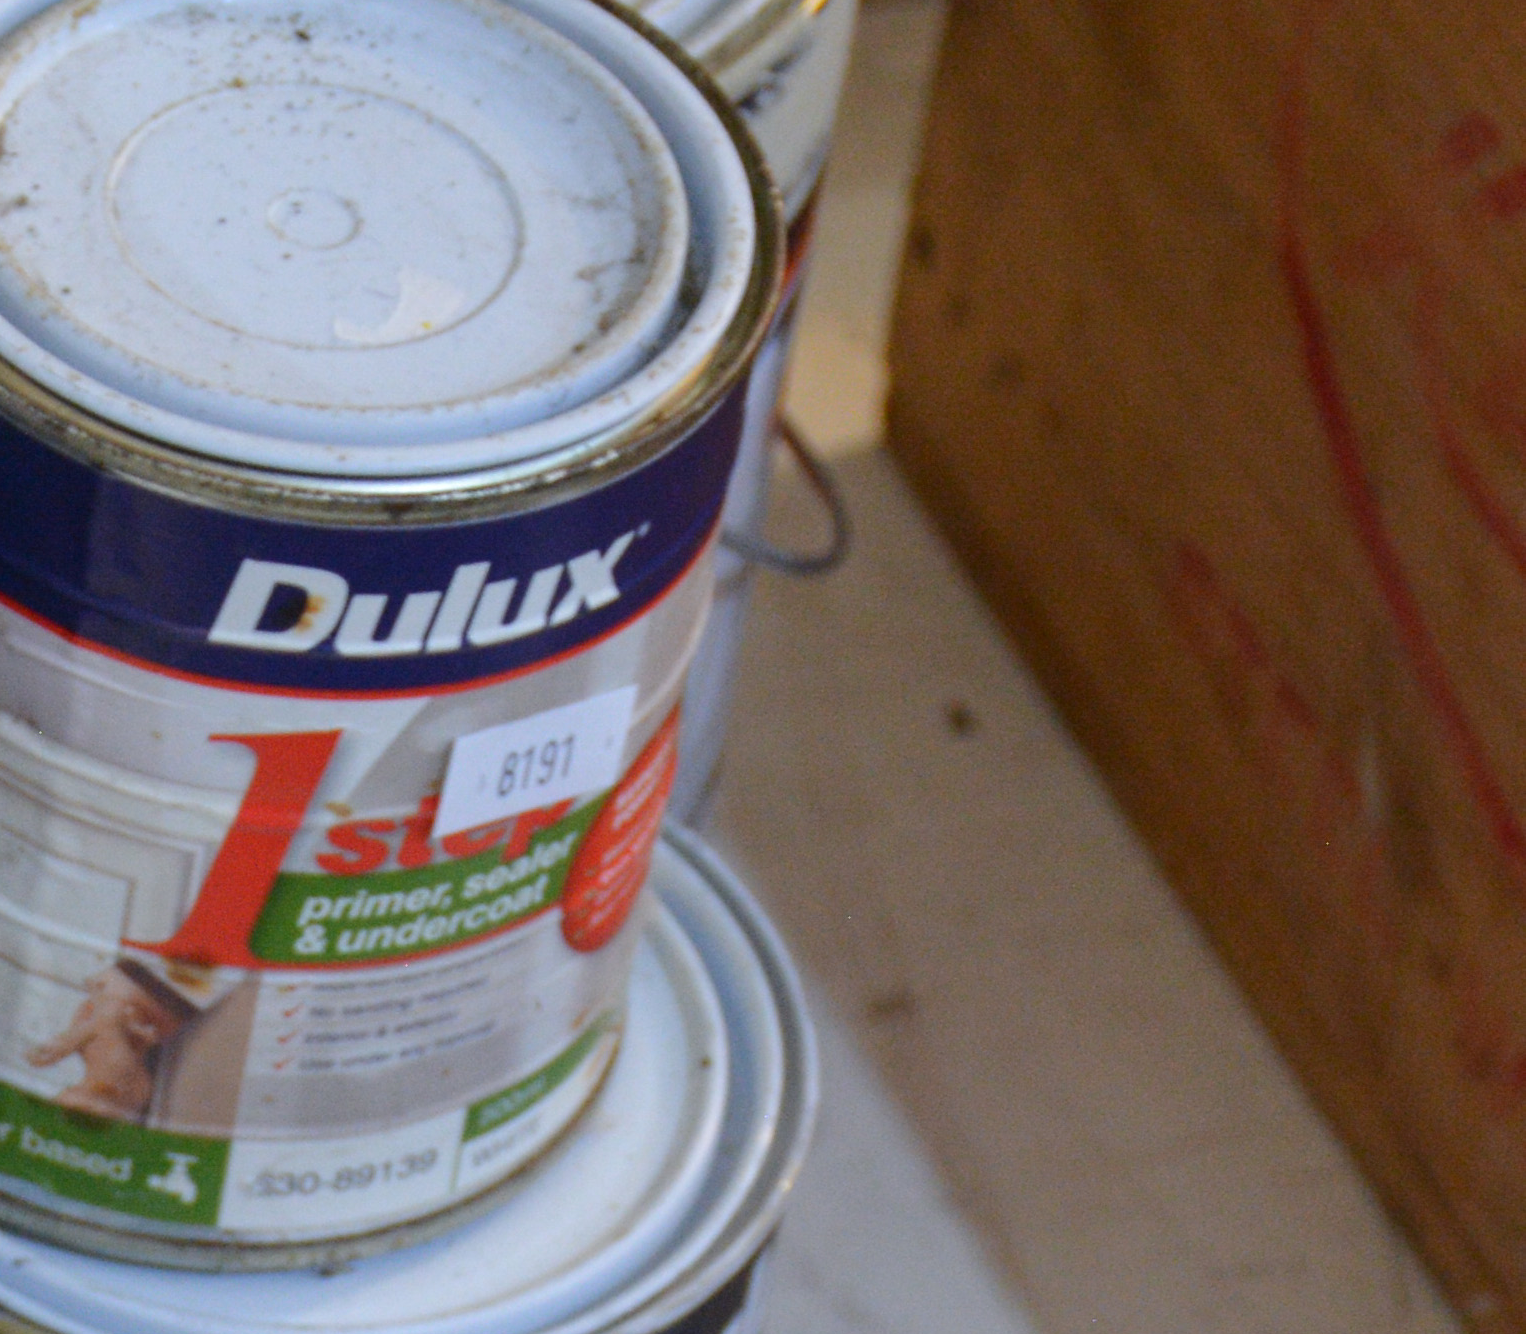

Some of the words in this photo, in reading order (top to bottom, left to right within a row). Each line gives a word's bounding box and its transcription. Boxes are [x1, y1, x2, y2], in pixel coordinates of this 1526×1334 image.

[206, 529, 636, 658] Dulux
[496, 732, 577, 799] 8191
[120, 728, 345, 968] 1
[297, 881, 454, 929] primer,
[461, 830, 579, 900] sealer
[293, 921, 328, 955] &
[335, 873, 549, 954] undercoat
[20, 1120, 134, 1184] based
